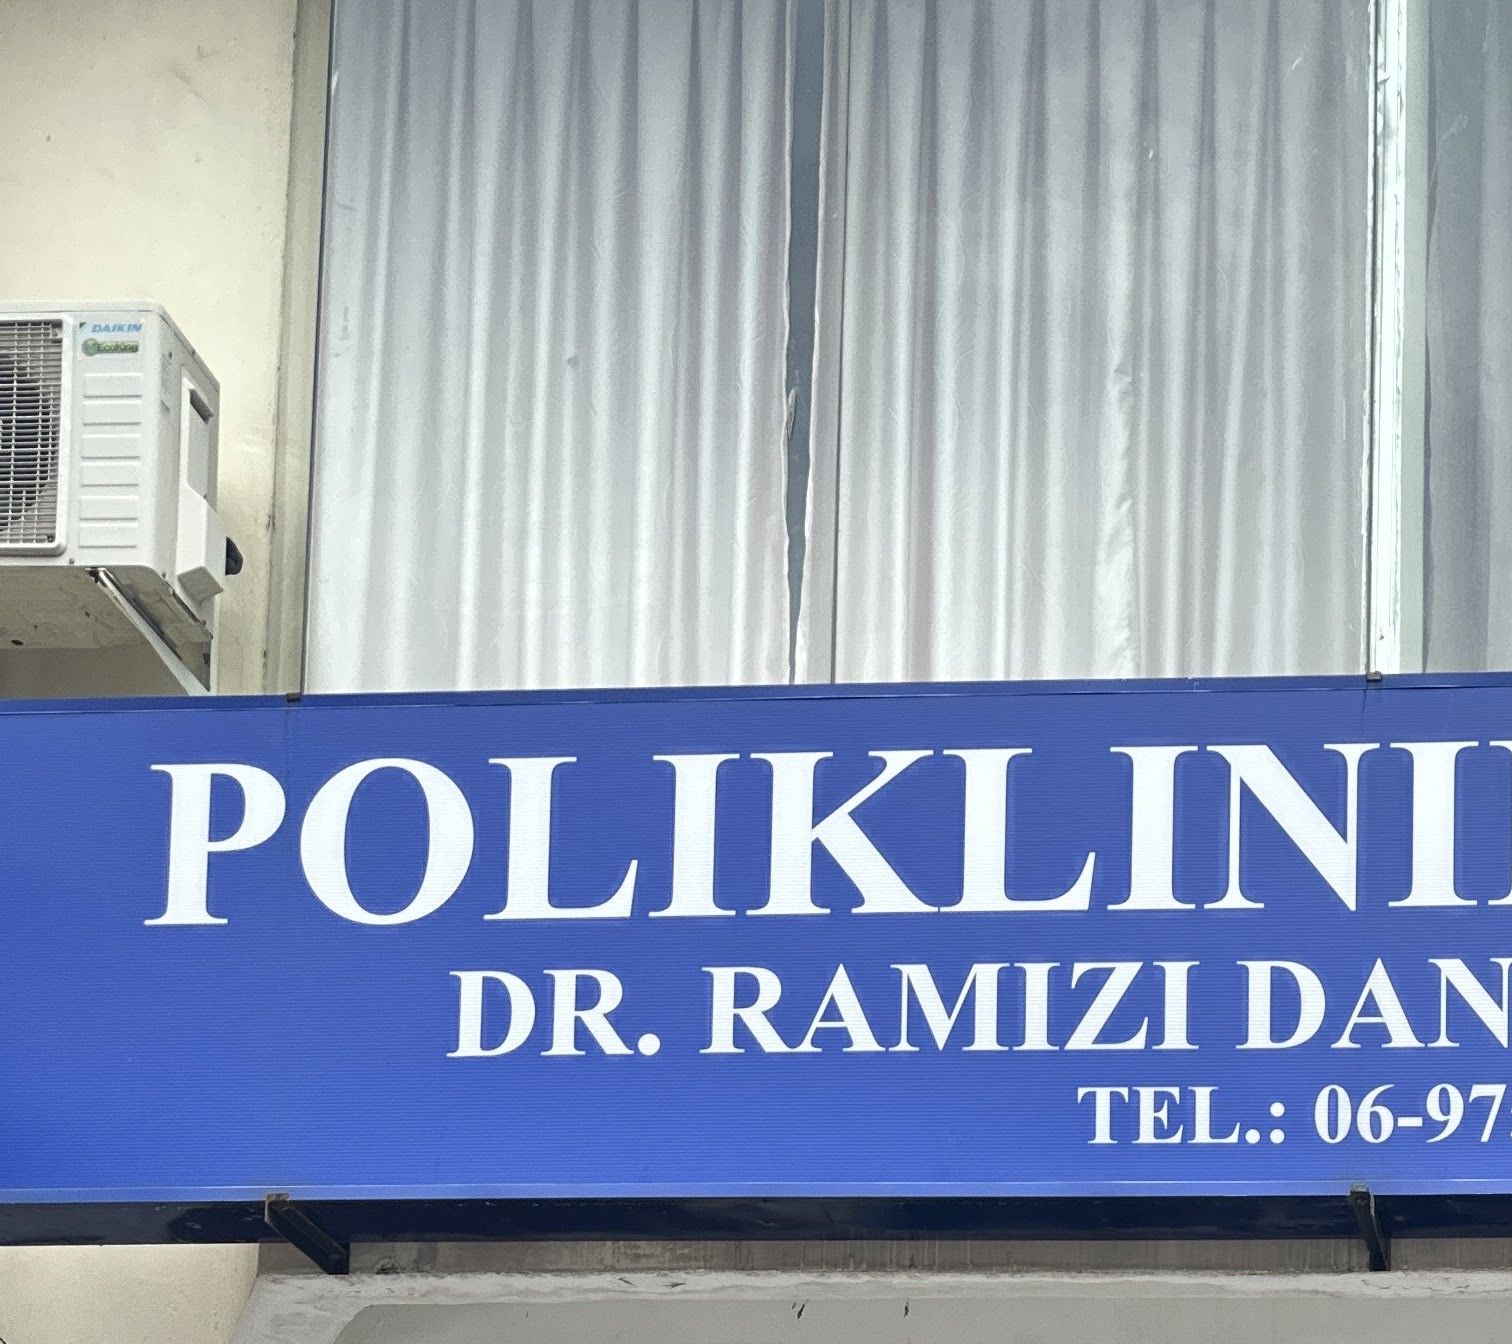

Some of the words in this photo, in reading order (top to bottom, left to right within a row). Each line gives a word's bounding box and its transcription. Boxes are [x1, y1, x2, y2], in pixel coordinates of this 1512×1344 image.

[91, 324, 142, 333] DAIKIN
[446, 967, 661, 1058] DR.
[700, 957, 1200, 1054] RAMIZI
[1076, 1083, 1287, 1146] TEL.:
